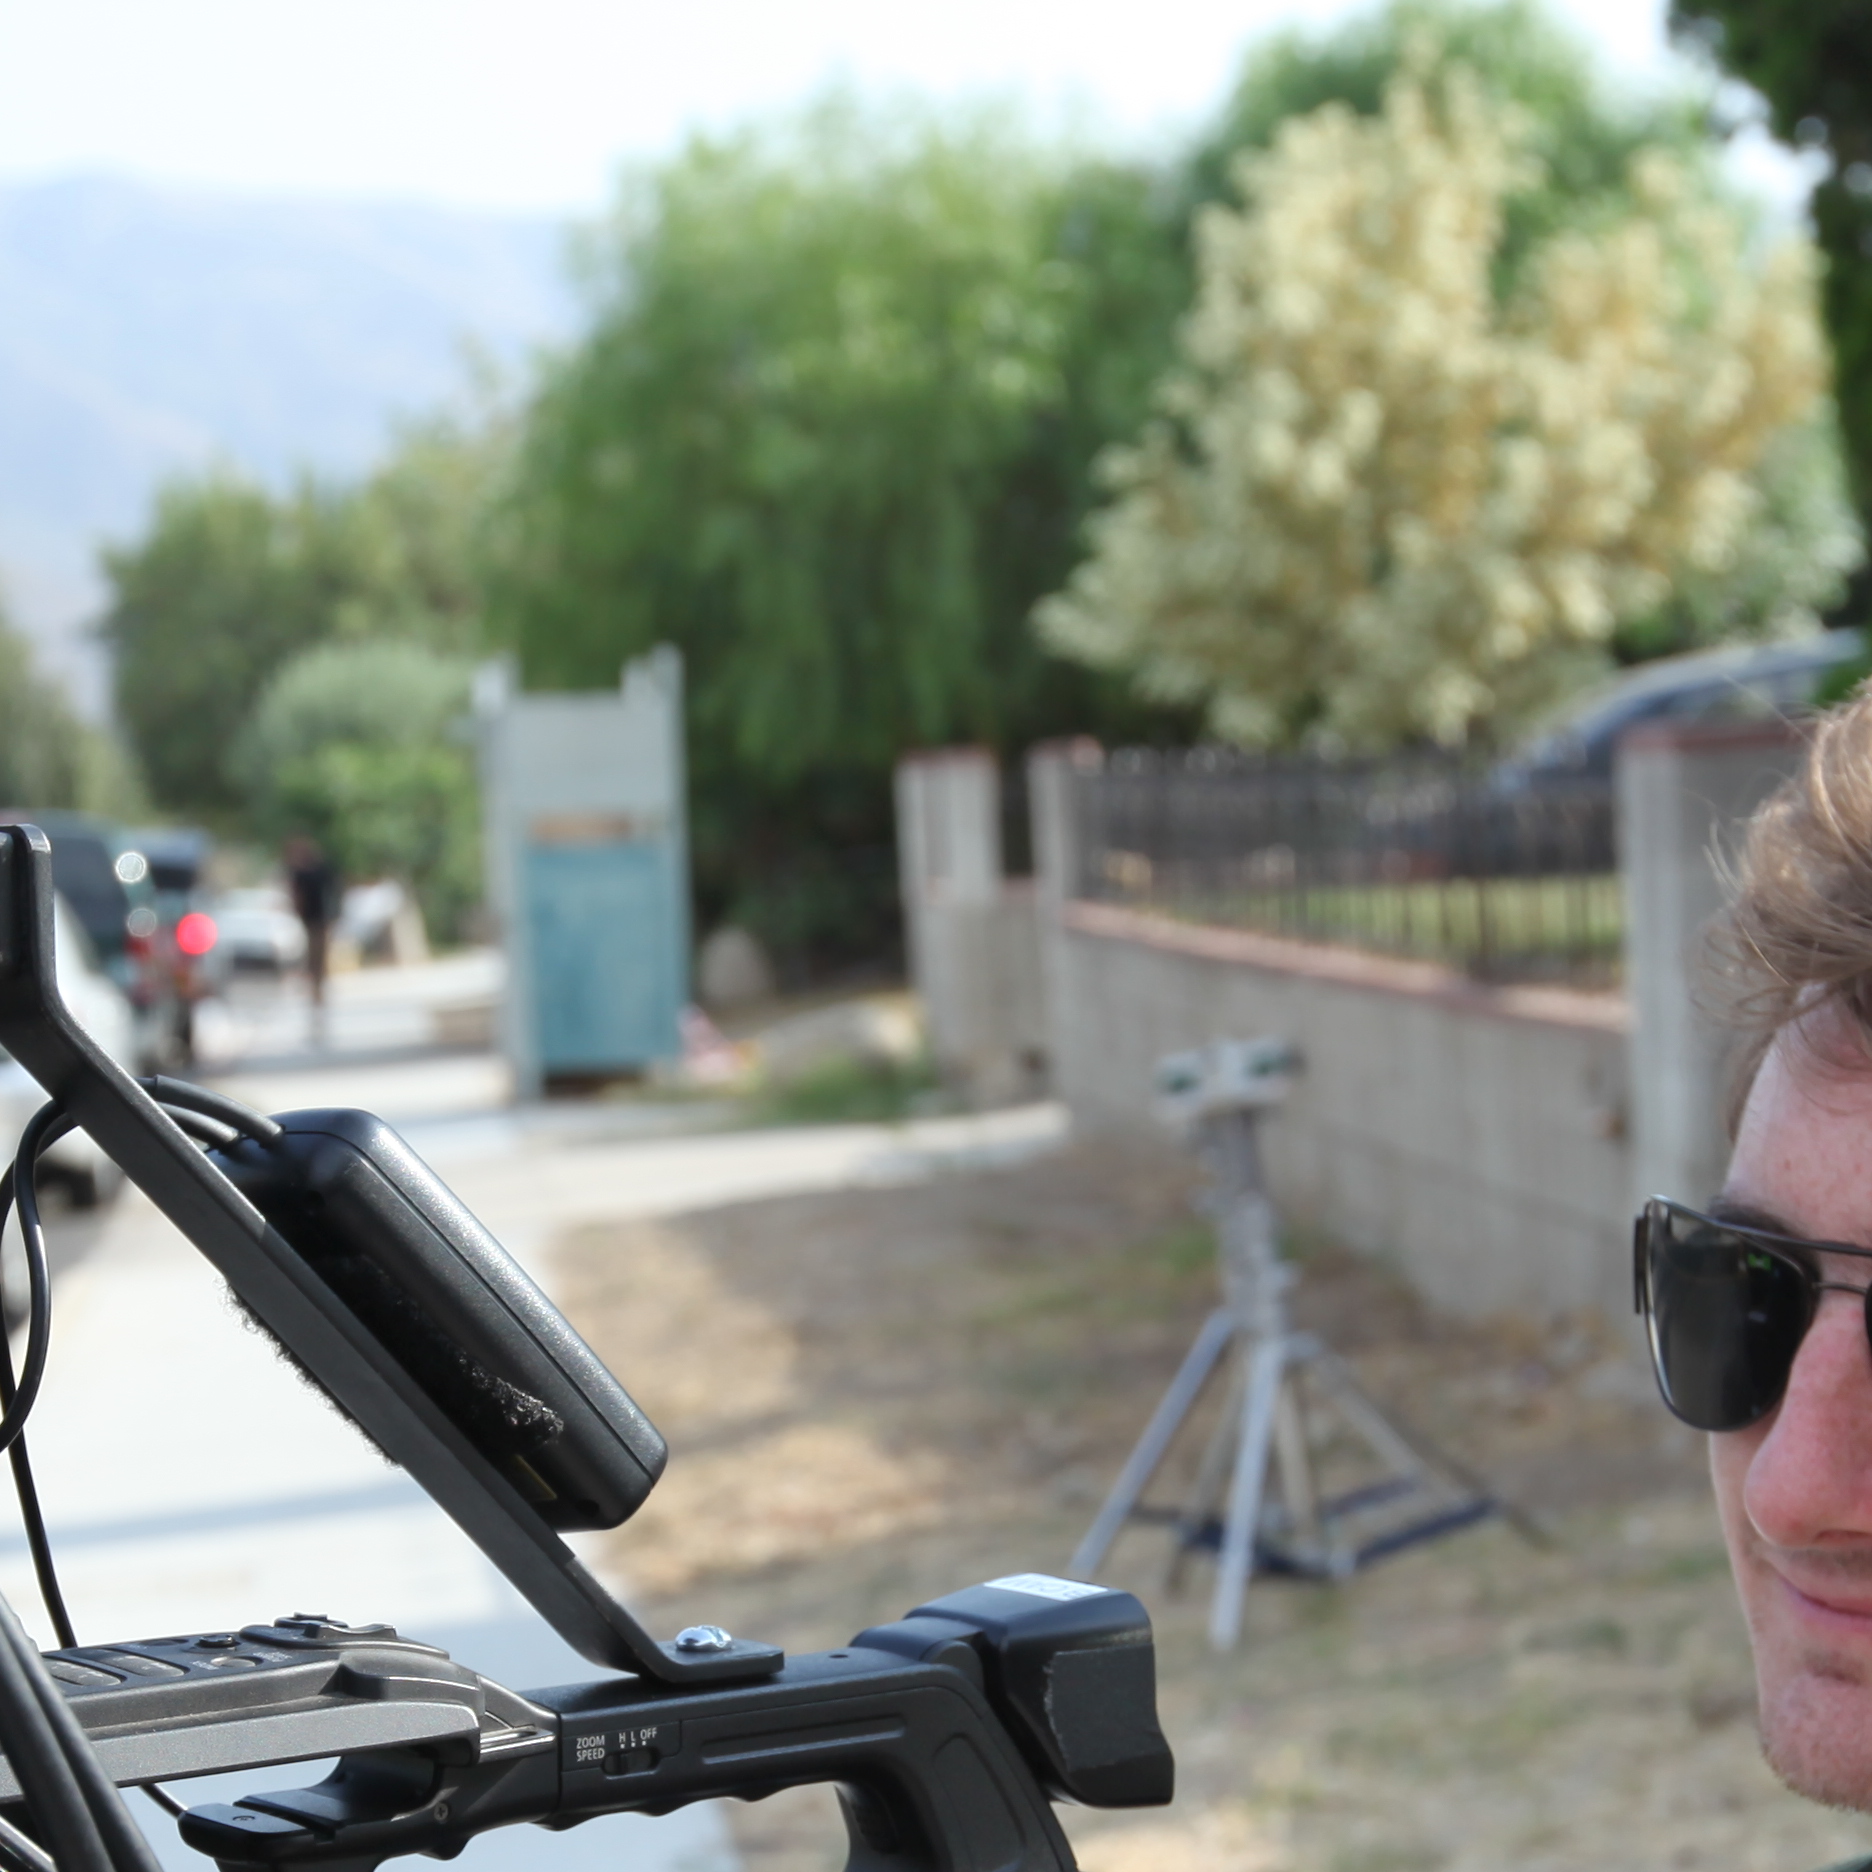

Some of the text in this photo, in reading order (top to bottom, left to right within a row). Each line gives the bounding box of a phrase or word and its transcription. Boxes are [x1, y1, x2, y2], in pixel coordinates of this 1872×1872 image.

[640, 1727, 657, 1740] OFF
[576, 1734, 605, 1750] ZOOM
[576, 1748, 605, 1762] SPEED
